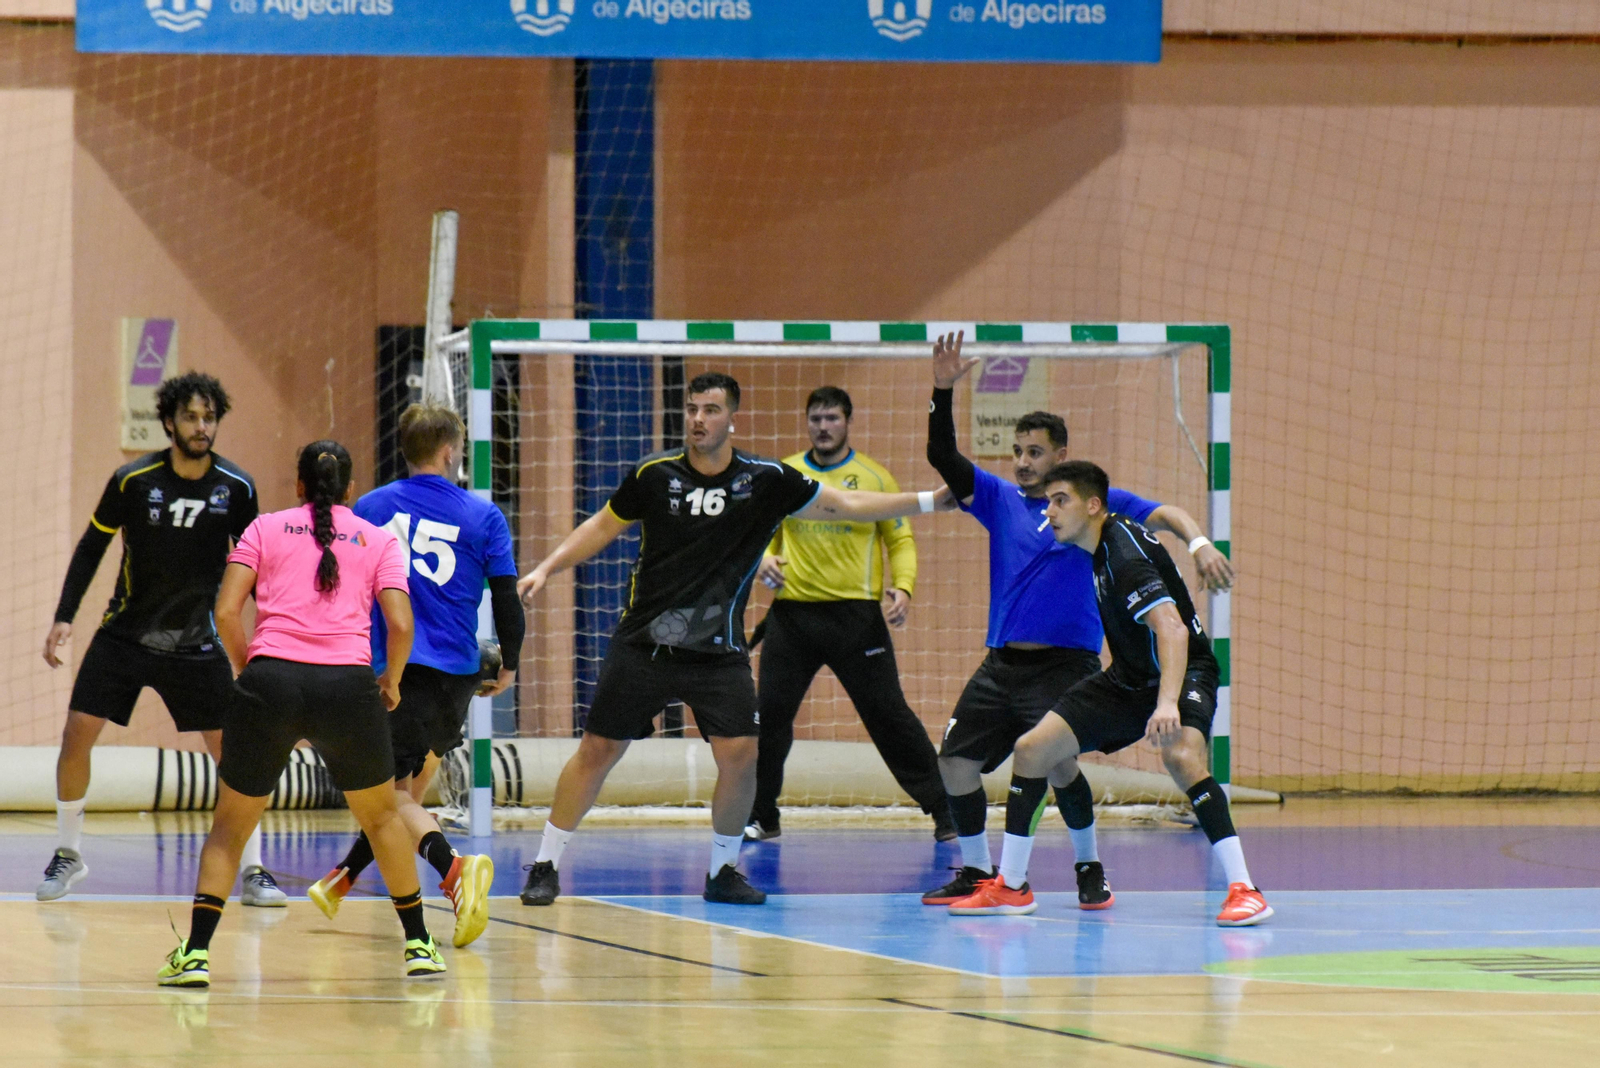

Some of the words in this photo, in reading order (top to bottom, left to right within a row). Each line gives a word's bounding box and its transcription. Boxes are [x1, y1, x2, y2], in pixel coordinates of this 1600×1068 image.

[263, 0, 393, 20] Algeciras
[592, 0, 619, 18] de
[624, 0, 751, 24] Algeciras
[950, 3, 975, 22] de
[981, 0, 1106, 28] Algeciras
[169, 498, 206, 528] 17
[686, 487, 727, 516] 16
[378, 511, 460, 587] 15
